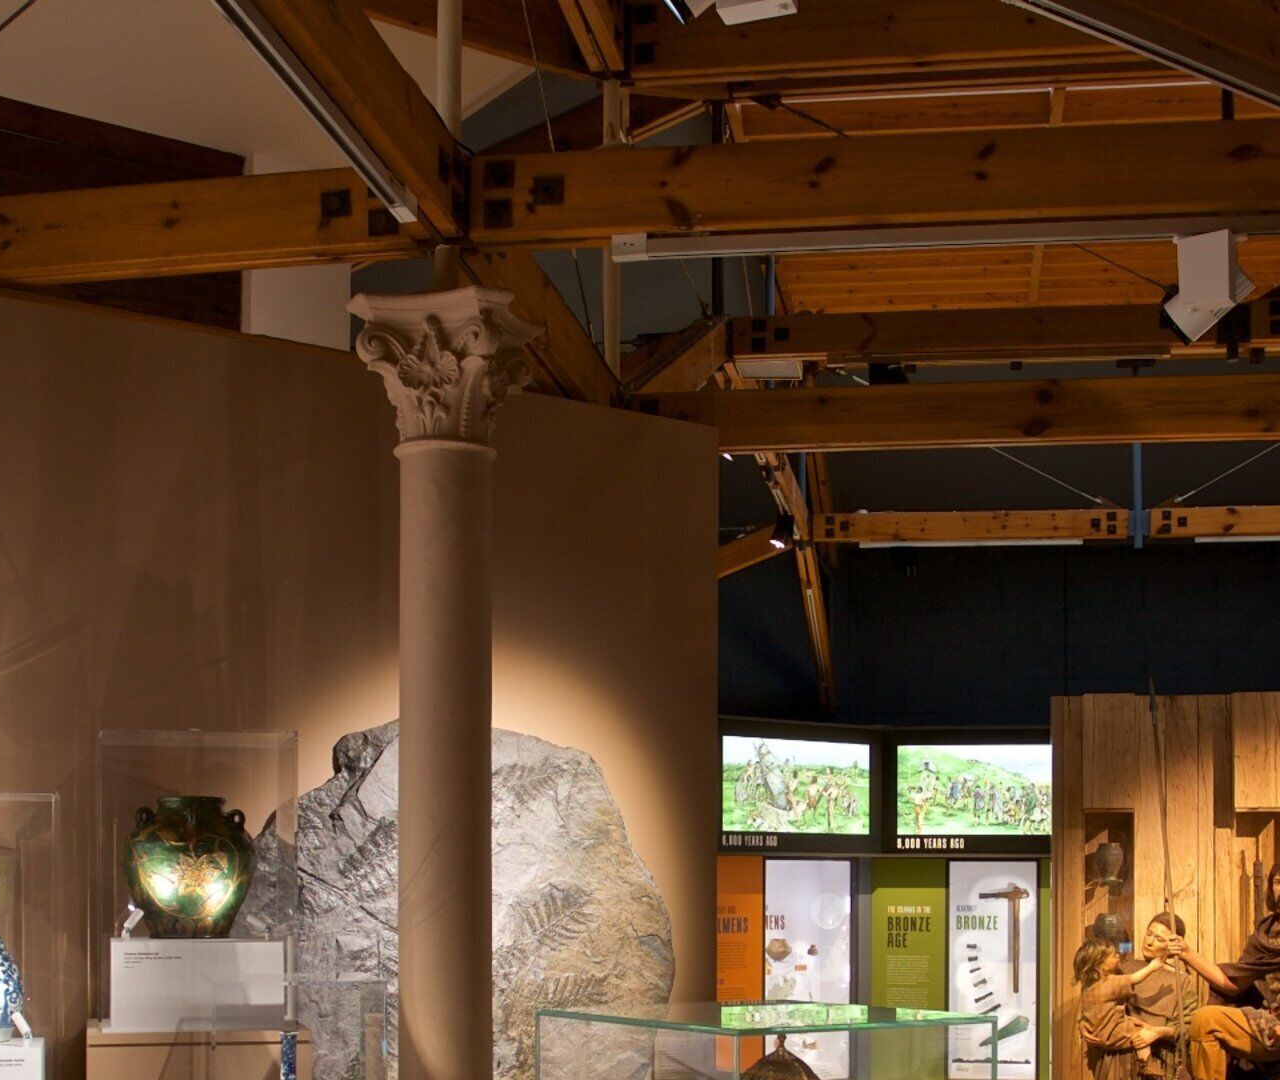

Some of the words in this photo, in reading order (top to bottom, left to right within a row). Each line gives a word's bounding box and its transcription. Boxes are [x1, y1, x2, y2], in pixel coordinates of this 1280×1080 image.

[744, 836, 764, 847] YEARS
[766, 836, 778, 847] AGO
[924, 838, 947, 849] YEARS
[950, 838, 965, 849] AGO
[887, 916, 931, 932] BRONZE
[956, 915, 998, 930] BRONZE
[887, 933, 907, 948] AGE
